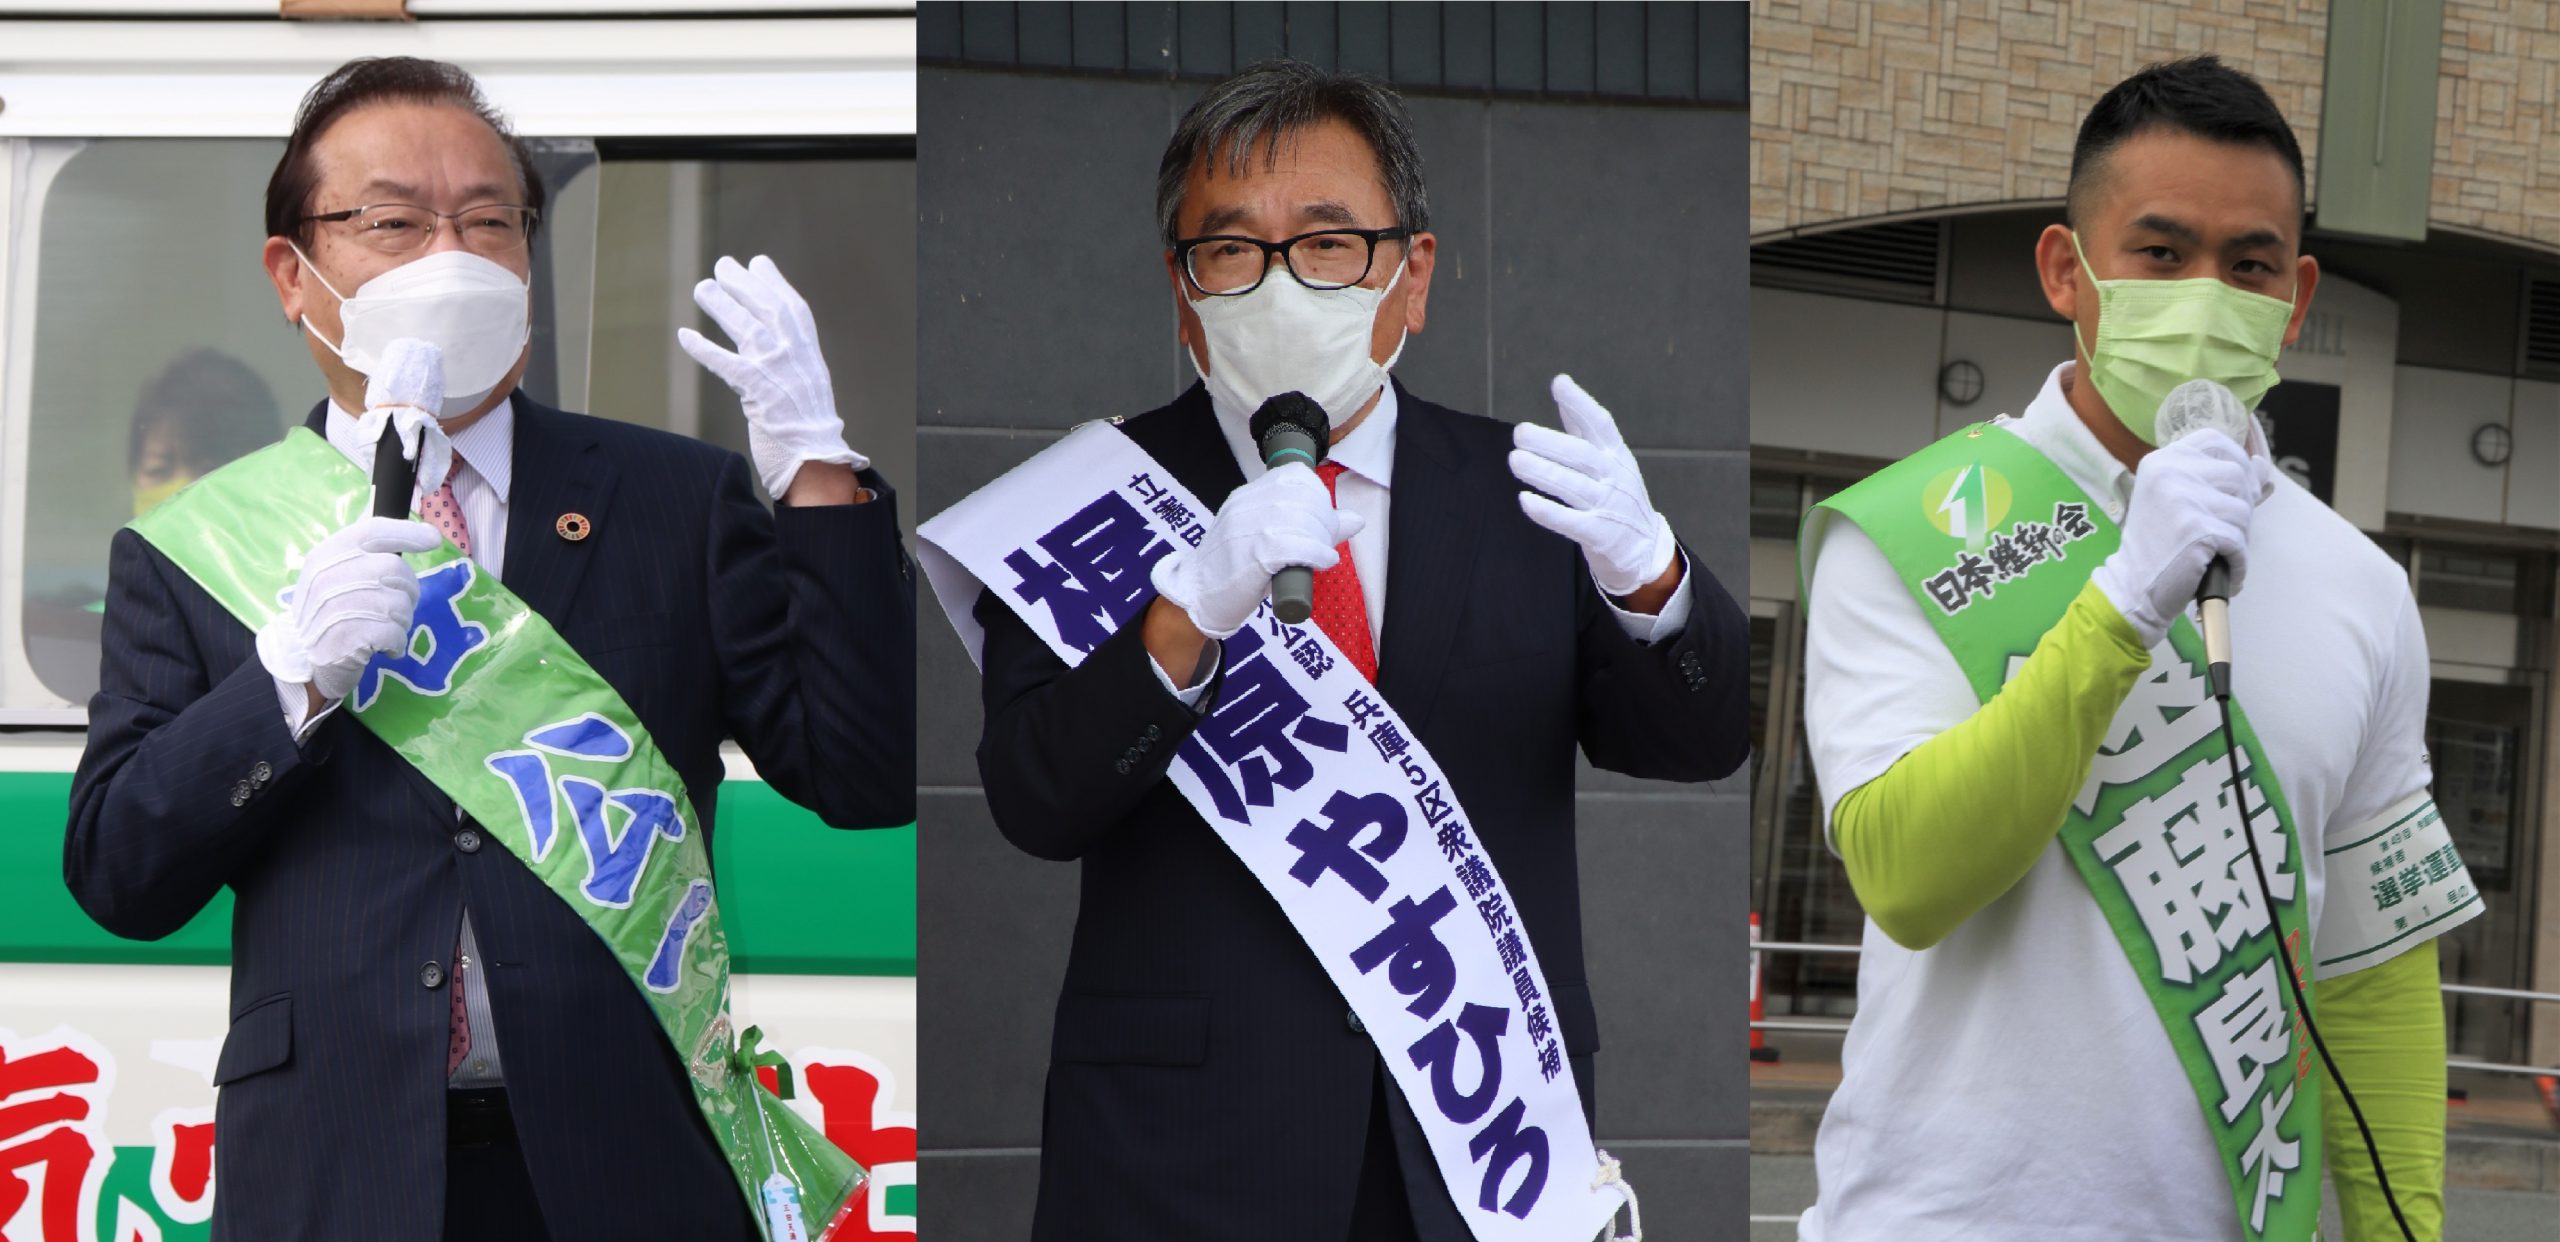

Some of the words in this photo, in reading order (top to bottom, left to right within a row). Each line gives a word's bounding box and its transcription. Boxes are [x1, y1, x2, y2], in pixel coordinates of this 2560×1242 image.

[1925, 503, 2095, 613] 日本維新の会
